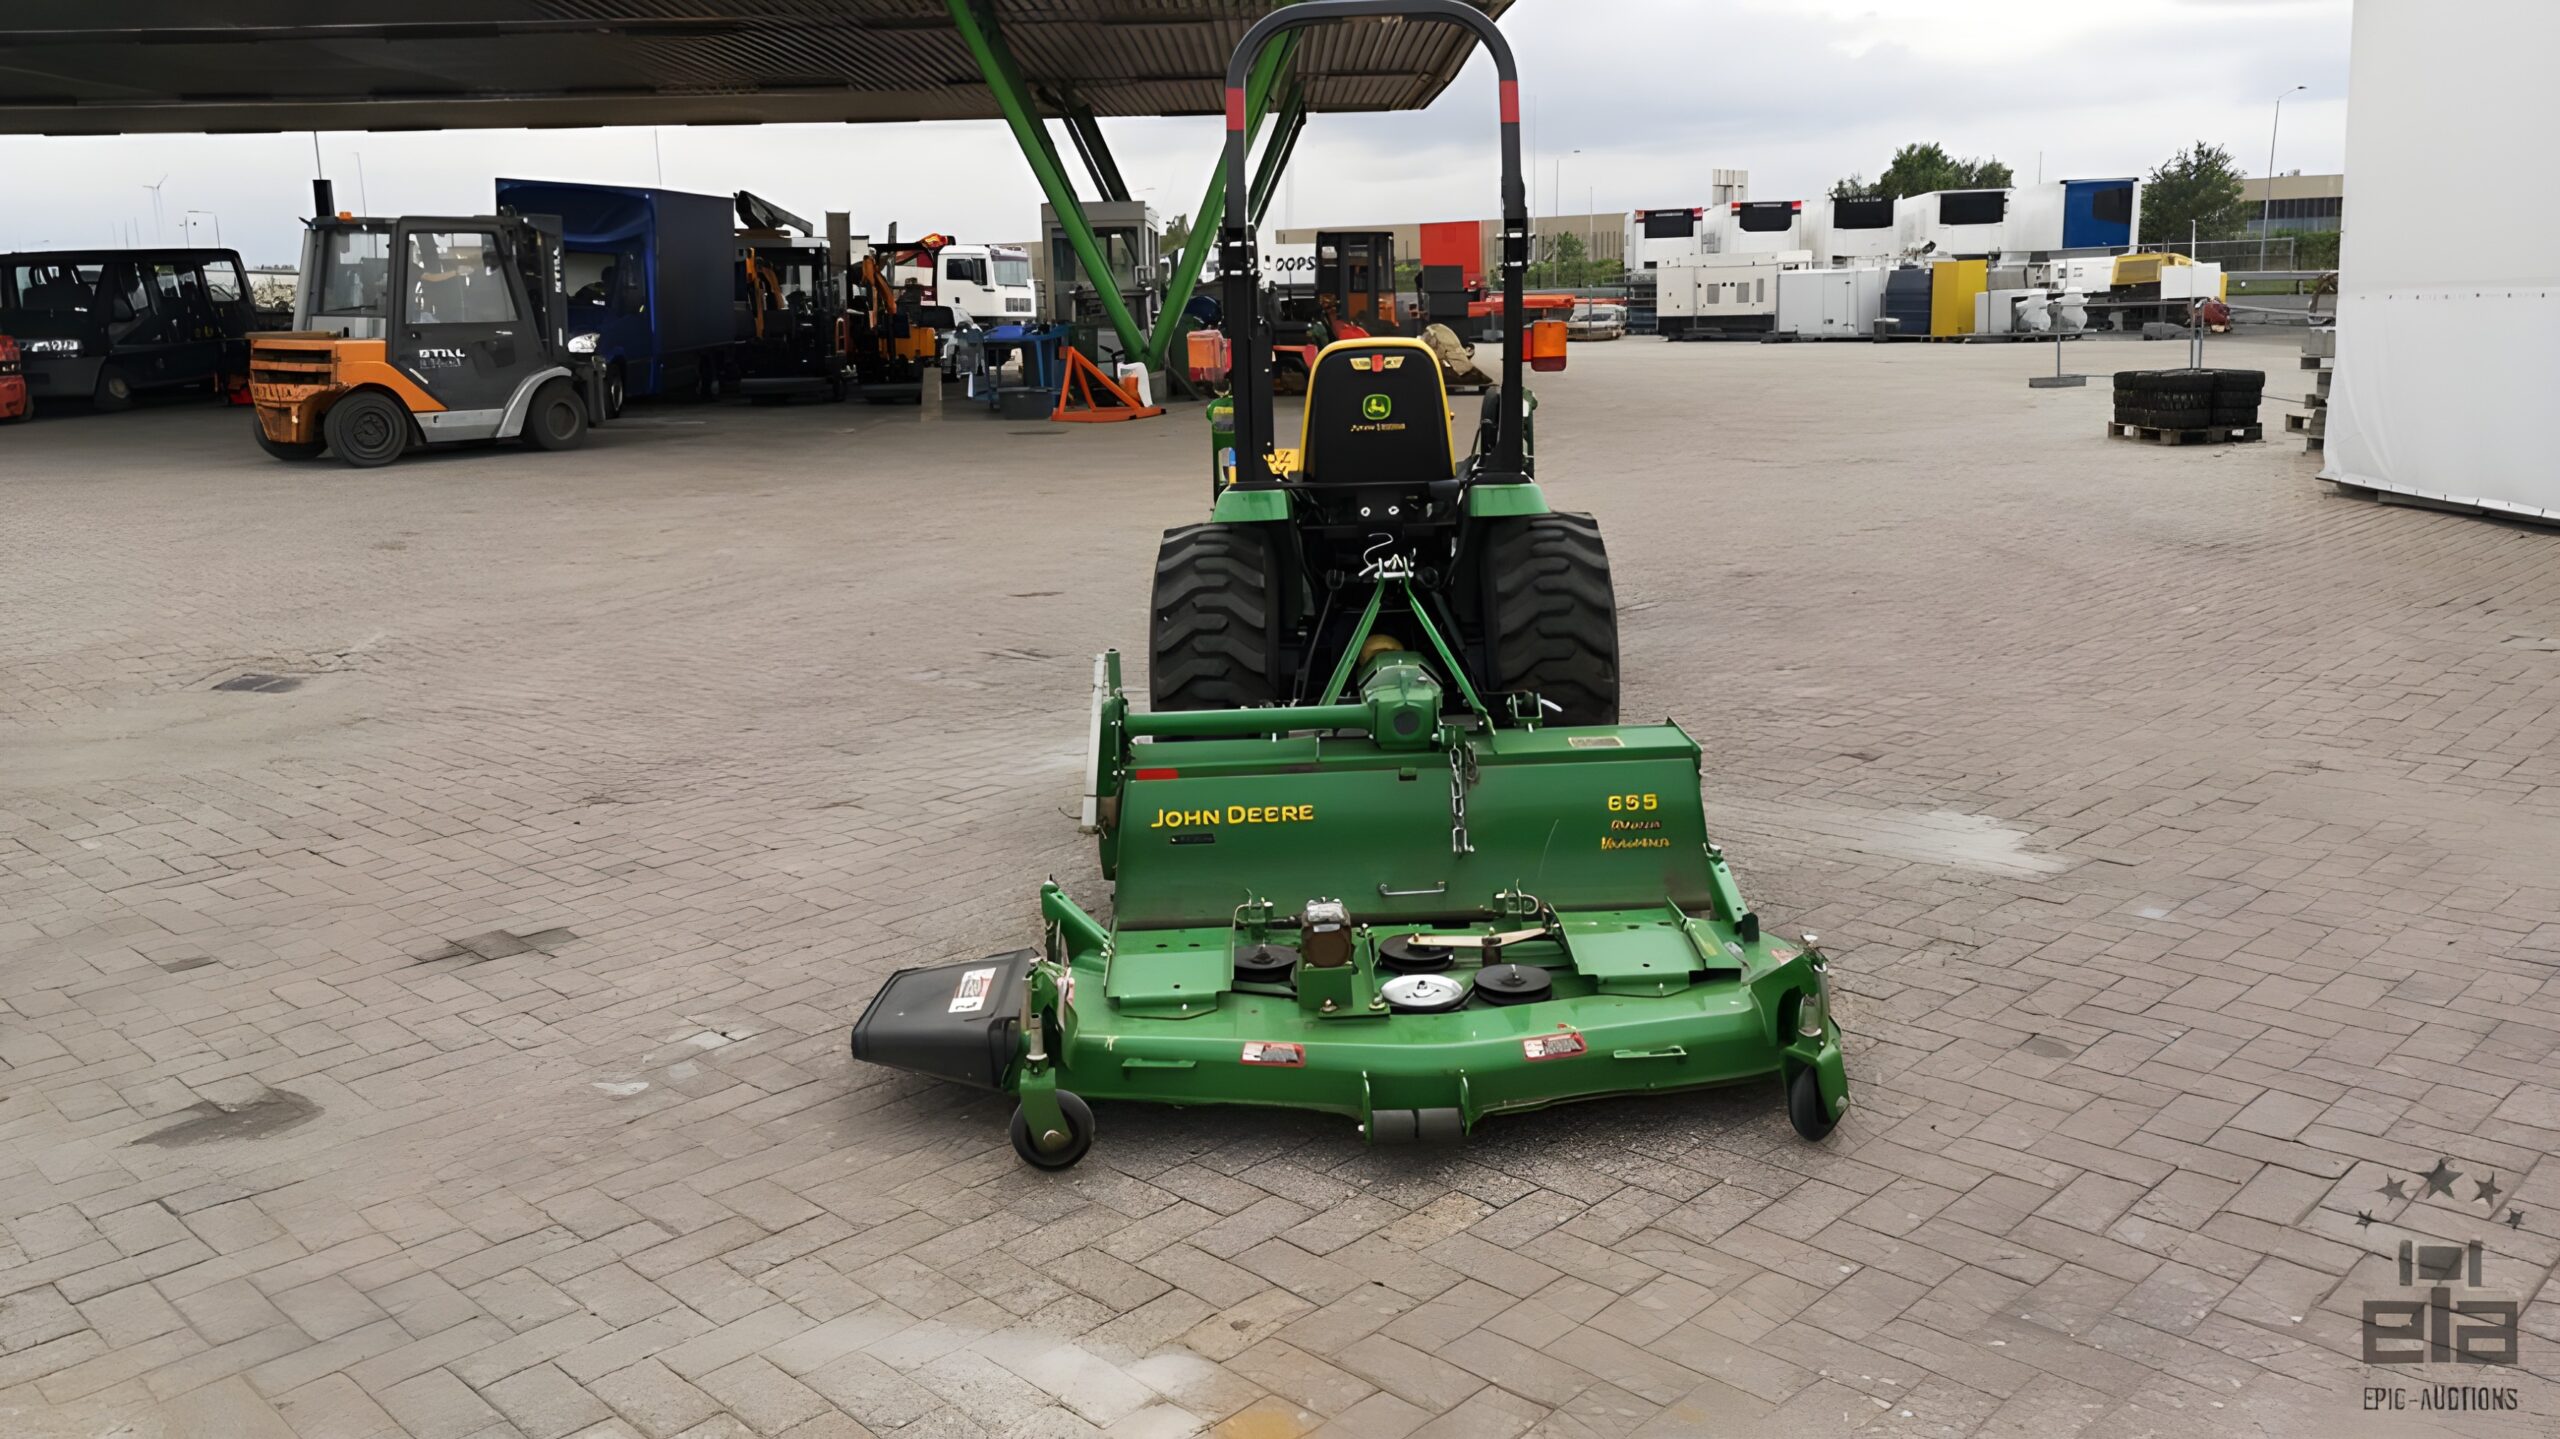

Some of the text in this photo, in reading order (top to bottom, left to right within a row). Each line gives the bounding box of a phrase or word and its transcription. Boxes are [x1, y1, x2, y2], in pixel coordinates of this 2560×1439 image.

[1608, 794, 1658, 811] 655
[1151, 805, 1314, 828] JOHN DEERE
